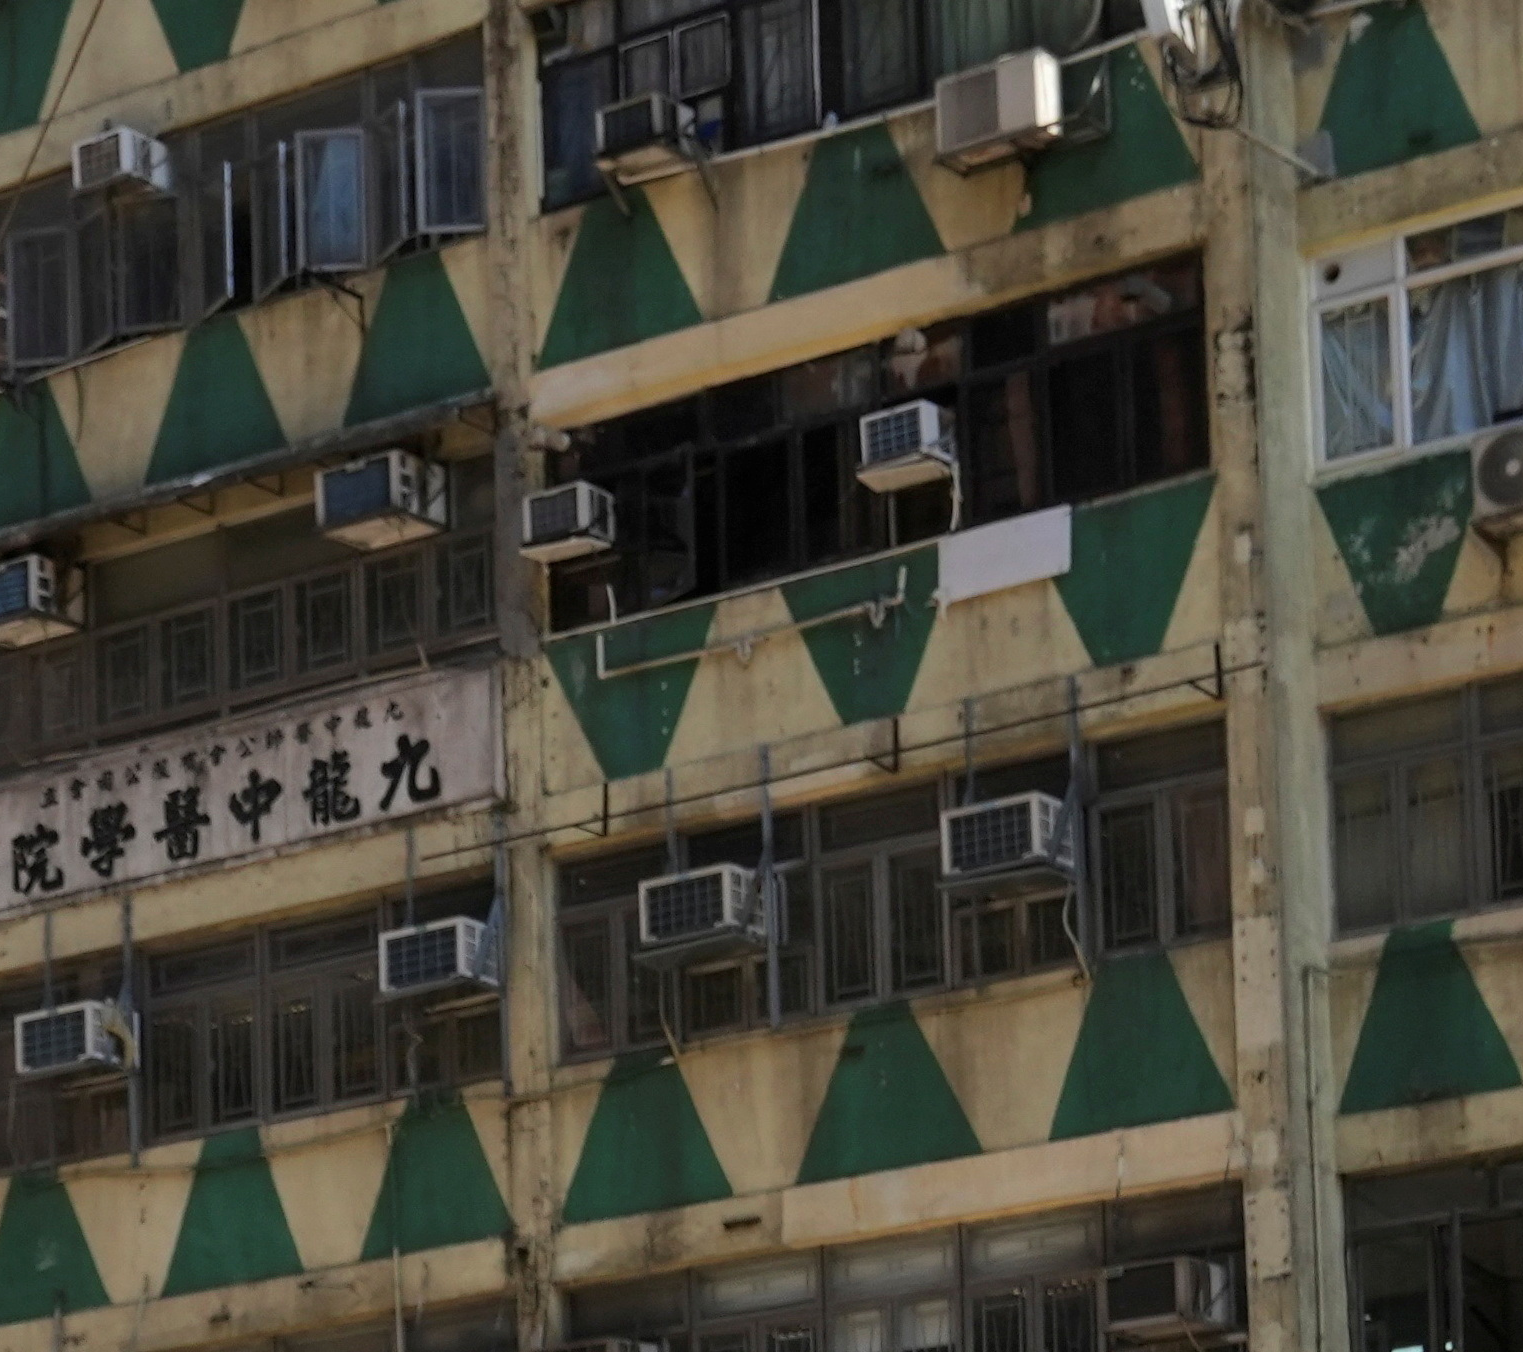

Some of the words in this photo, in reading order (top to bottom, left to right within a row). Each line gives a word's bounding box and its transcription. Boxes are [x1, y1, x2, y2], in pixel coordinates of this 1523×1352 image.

[11, 735, 442, 896] 九龍中醫學院
